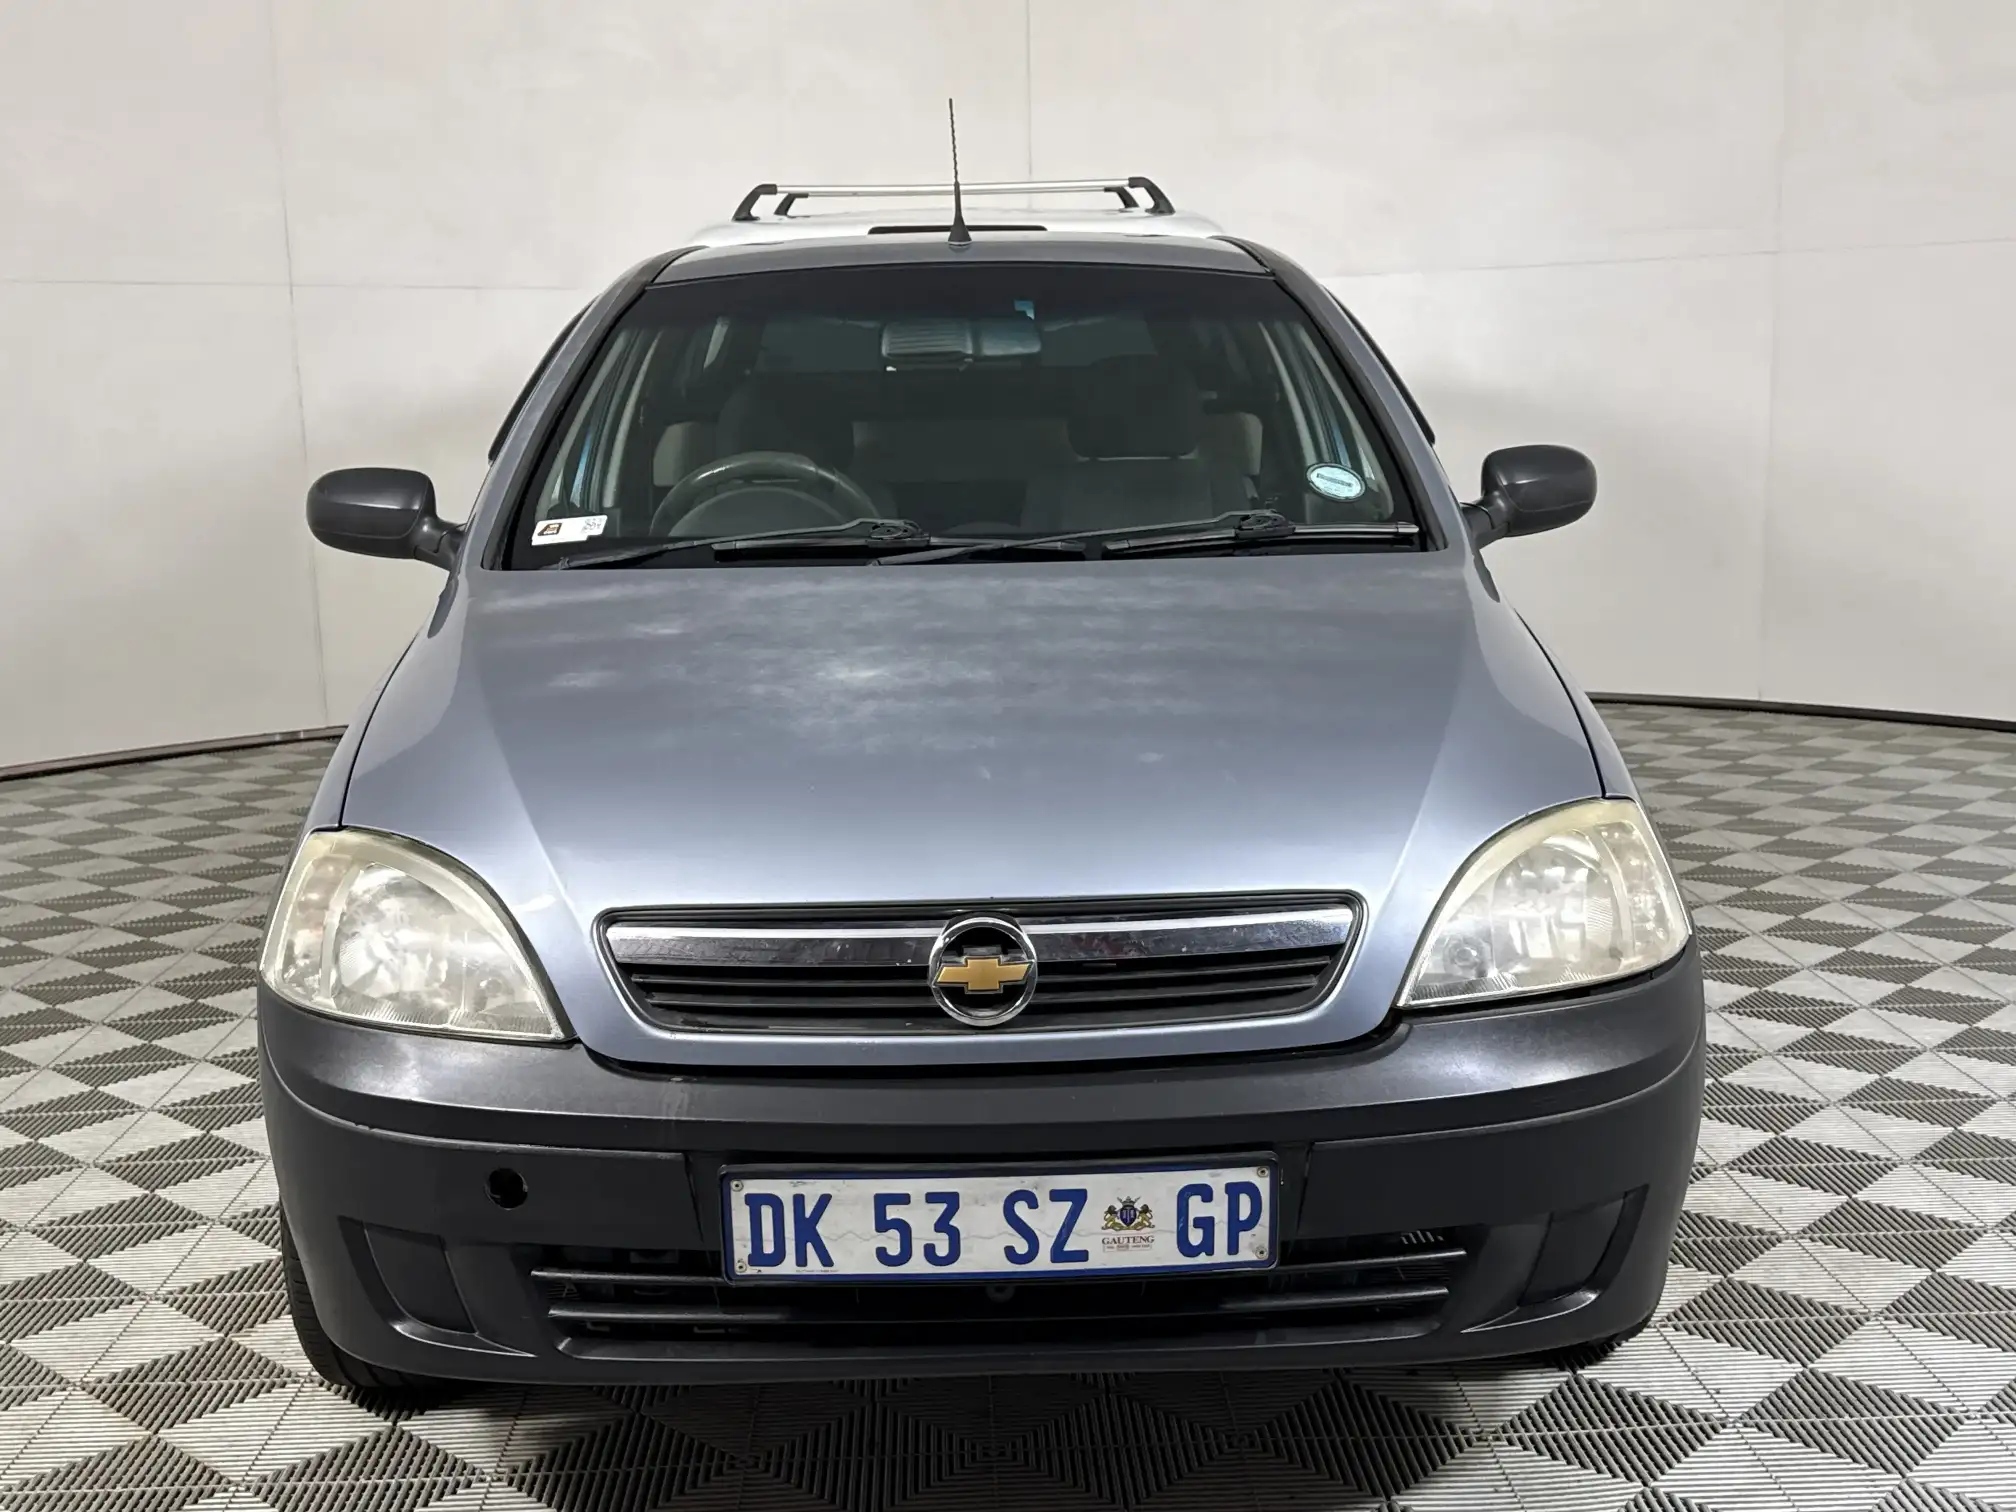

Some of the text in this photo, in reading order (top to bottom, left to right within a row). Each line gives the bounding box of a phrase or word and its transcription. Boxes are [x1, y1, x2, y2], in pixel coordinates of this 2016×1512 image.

[744, 1181, 1263, 1268] DK 53 SZ GP
[1101, 1235, 1155, 1245] GAUTENG
